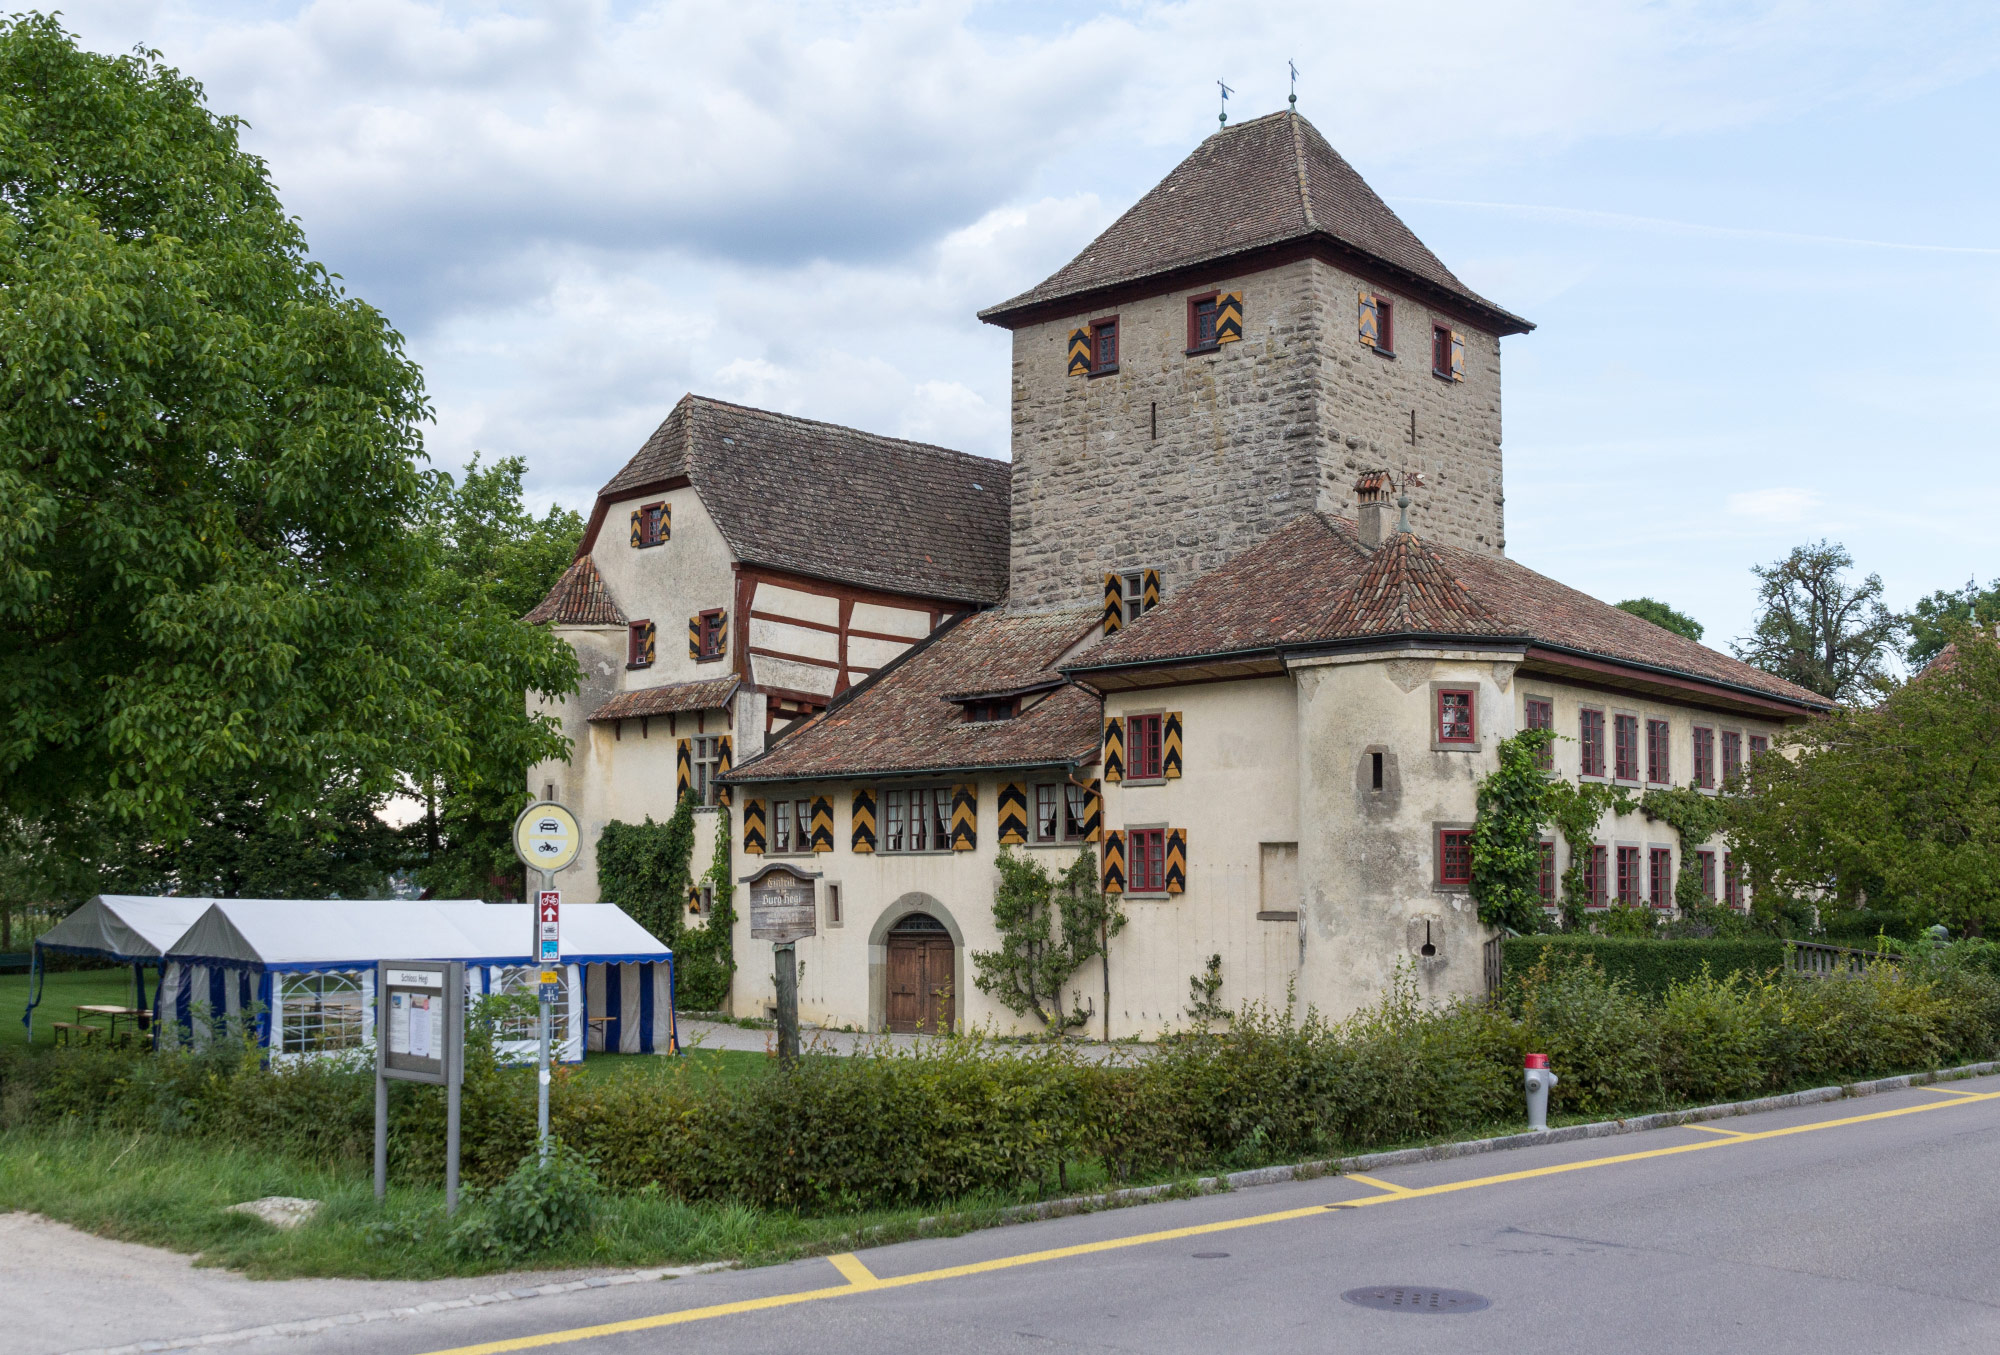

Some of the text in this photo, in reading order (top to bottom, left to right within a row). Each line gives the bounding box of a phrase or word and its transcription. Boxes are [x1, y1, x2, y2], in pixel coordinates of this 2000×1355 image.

[767, 877, 796, 888] Eintritt
[762, 893, 801, 905] Burg Hegi
[401, 973, 429, 985] Schloss Hegi
